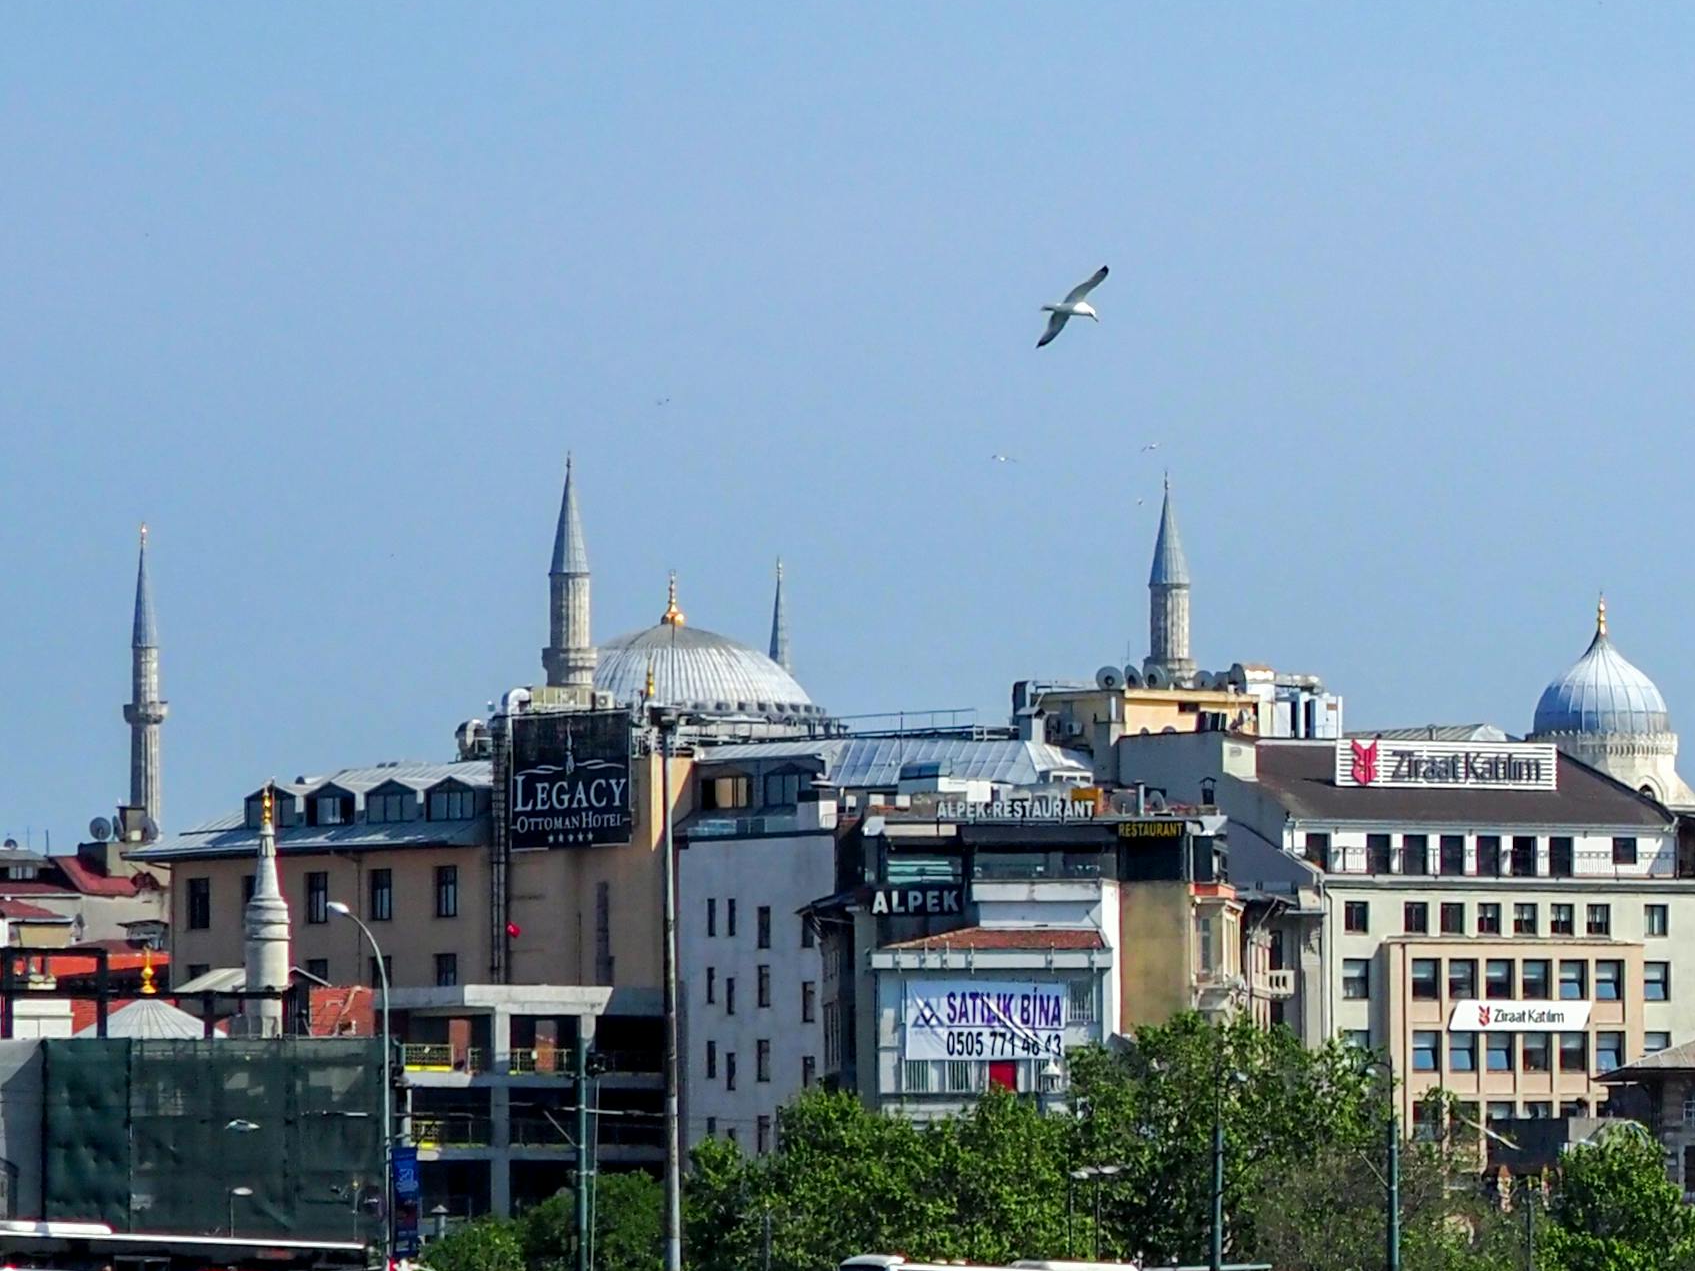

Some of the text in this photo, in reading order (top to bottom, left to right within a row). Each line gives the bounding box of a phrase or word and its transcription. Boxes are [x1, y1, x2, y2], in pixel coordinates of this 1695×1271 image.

[1391, 750, 1459, 782] Ziraat
[513, 775, 627, 812] LEGACY
[937, 801, 1095, 818] ALPEK RESTAURANT
[516, 815, 580, 834] OTTOMAN
[1118, 821, 1183, 838] RESTAURANT
[871, 890, 960, 914] ALPEK
[946, 987, 1062, 1027] SATILIK BİNA
[1494, 1009, 1526, 1023] Ziraat
[946, 1031, 984, 1057] 0505
[990, 1032, 1016, 1057] 771
